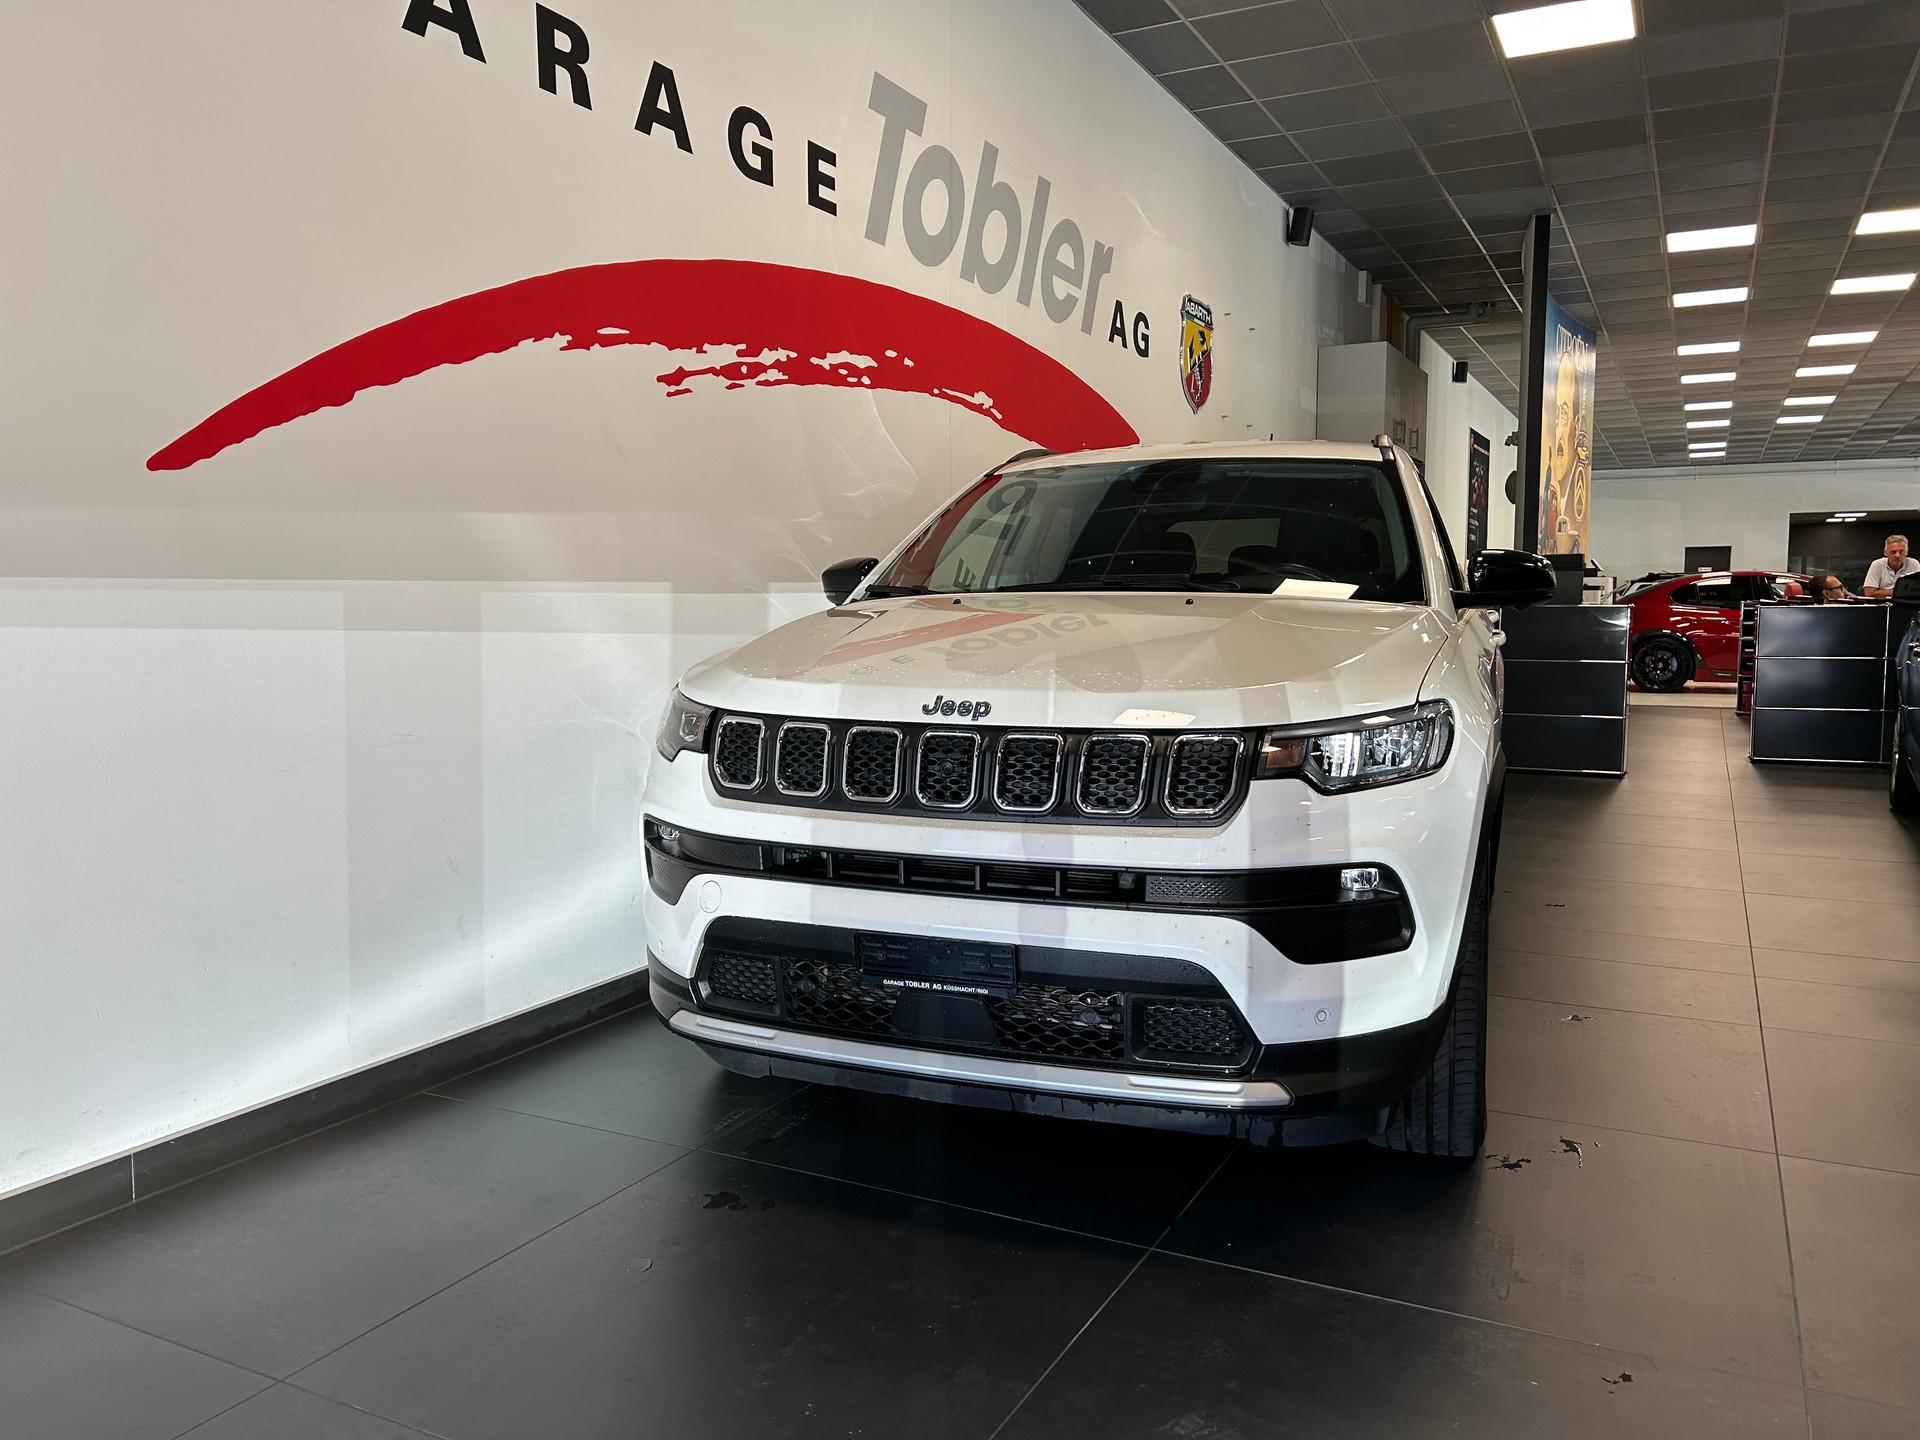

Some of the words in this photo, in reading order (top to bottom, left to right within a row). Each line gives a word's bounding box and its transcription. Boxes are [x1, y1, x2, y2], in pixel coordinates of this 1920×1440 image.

[864, 70, 1114, 336] Tobler
[1108, 299, 1150, 358] AG
[1186, 302, 1211, 324] ABARTH
[921, 695, 992, 721] Jeep
[882, 979, 905, 987] GARAGE
[905, 980, 930, 989] TOBLER
